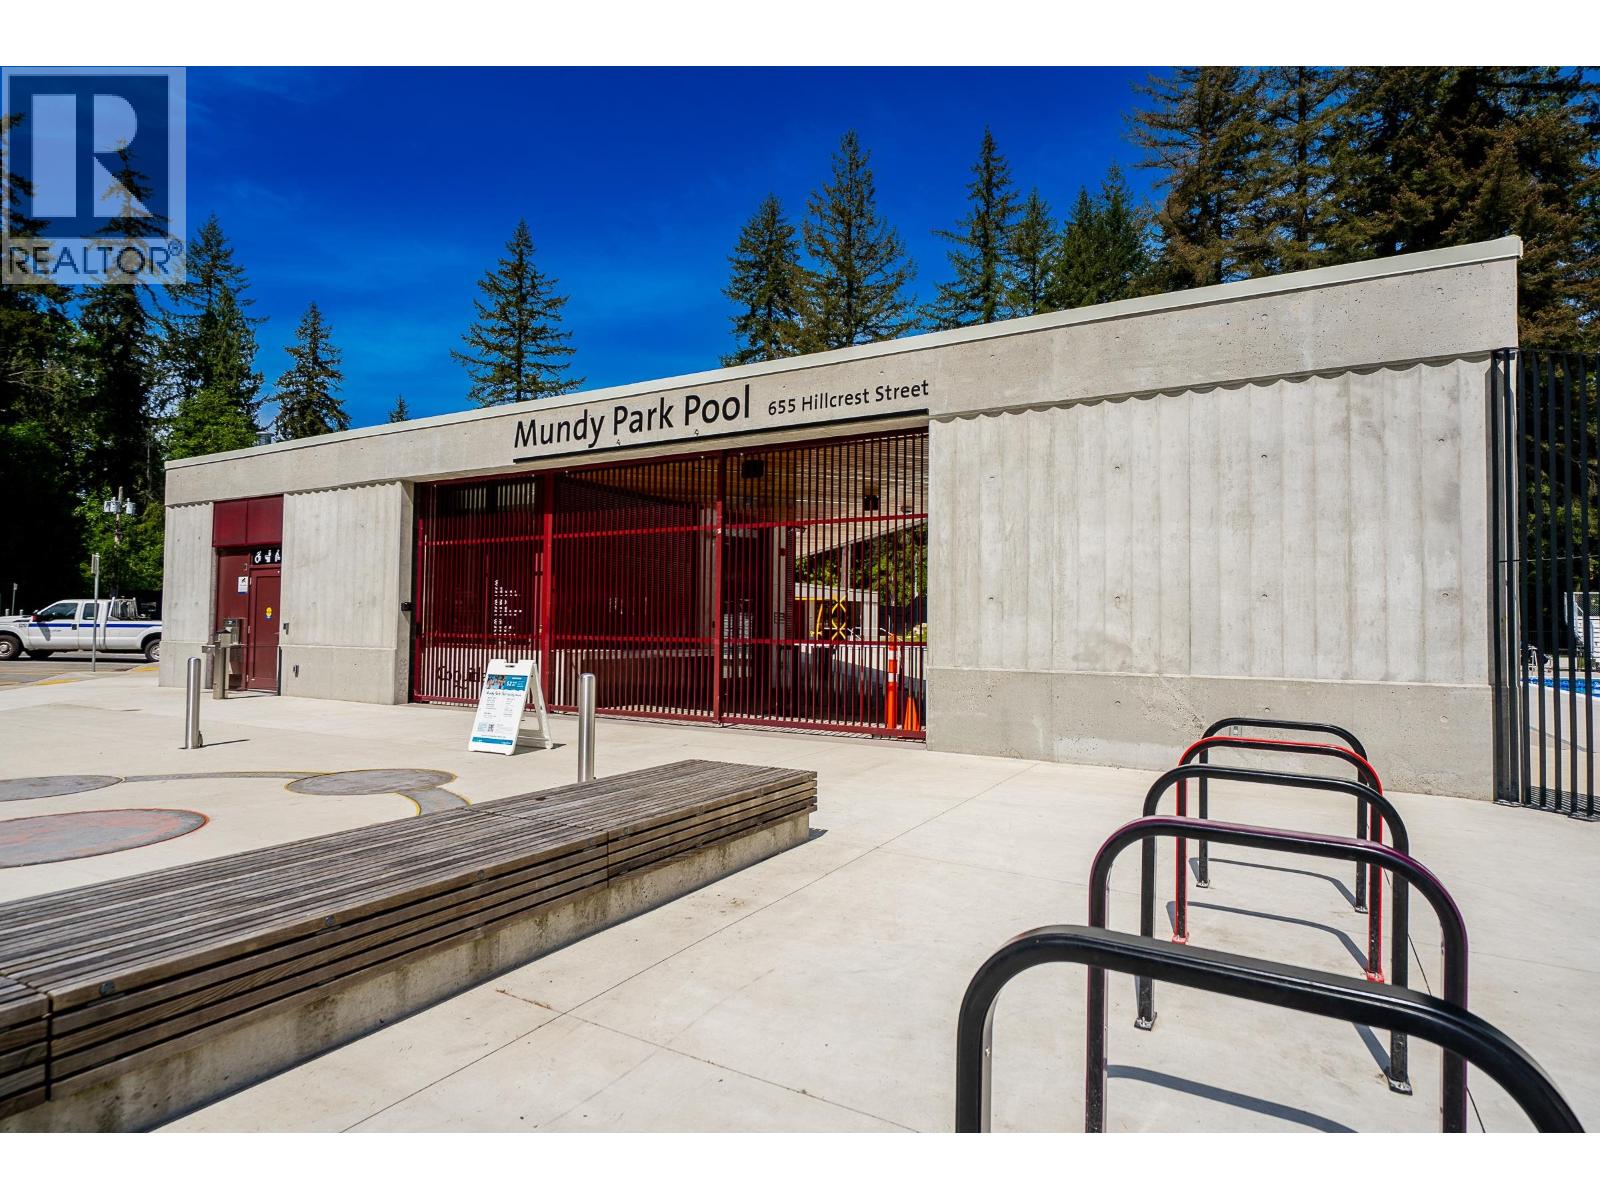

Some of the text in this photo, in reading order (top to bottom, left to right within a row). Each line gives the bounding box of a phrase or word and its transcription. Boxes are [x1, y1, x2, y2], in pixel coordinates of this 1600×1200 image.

[513, 379, 929, 450] Mundy Park Pool 655 Hillcrest Street
